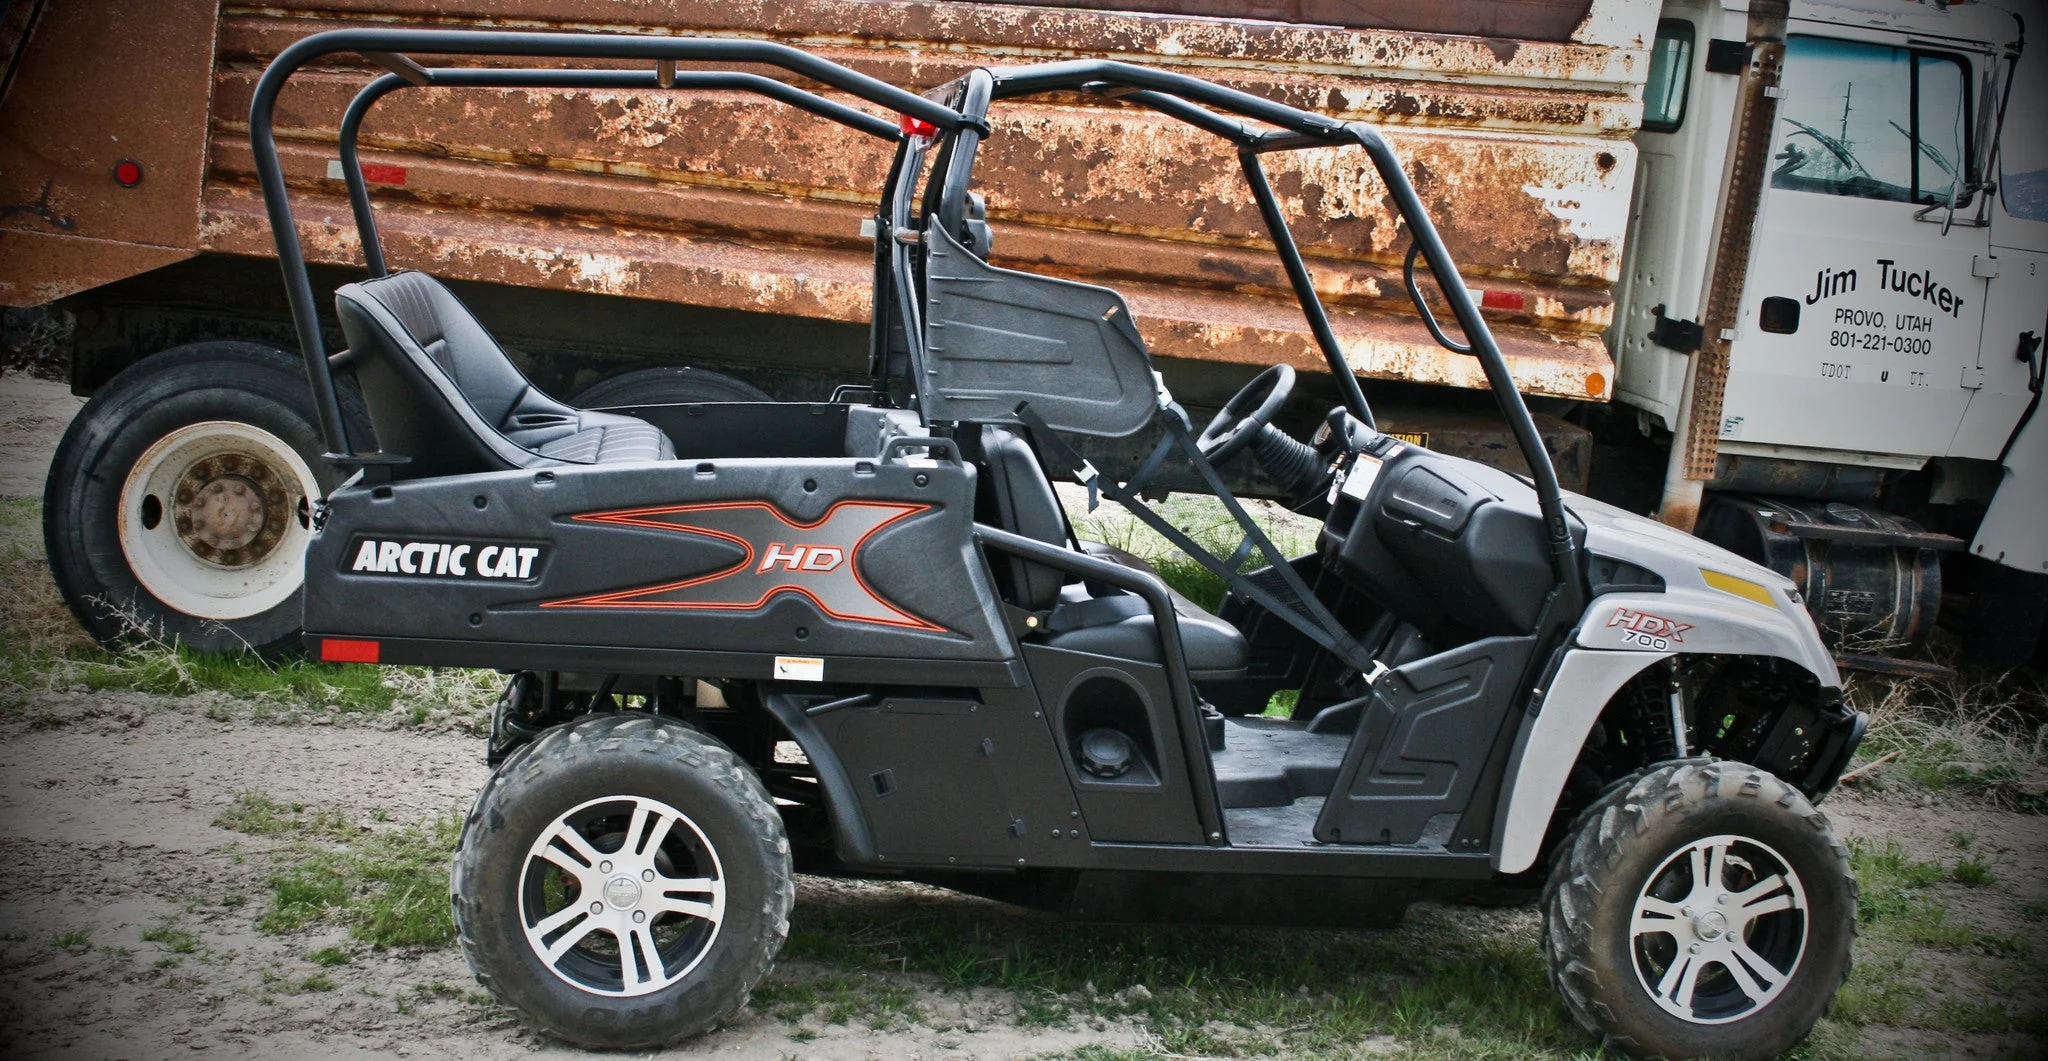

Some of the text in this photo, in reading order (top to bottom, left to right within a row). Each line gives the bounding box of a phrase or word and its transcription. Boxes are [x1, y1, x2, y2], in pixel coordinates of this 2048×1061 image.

[1806, 259, 1964, 318] Jim Tucker
[1835, 308, 1932, 332] PROVO, UTAH
[1830, 331, 1932, 355] 801-221-0300
[1880, 371, 1889, 382] U
[352, 540, 539, 578] ARCTIC CAT
[757, 544, 844, 574] HD
[1607, 608, 1696, 642] HDX
[1623, 630, 1668, 650] 700
